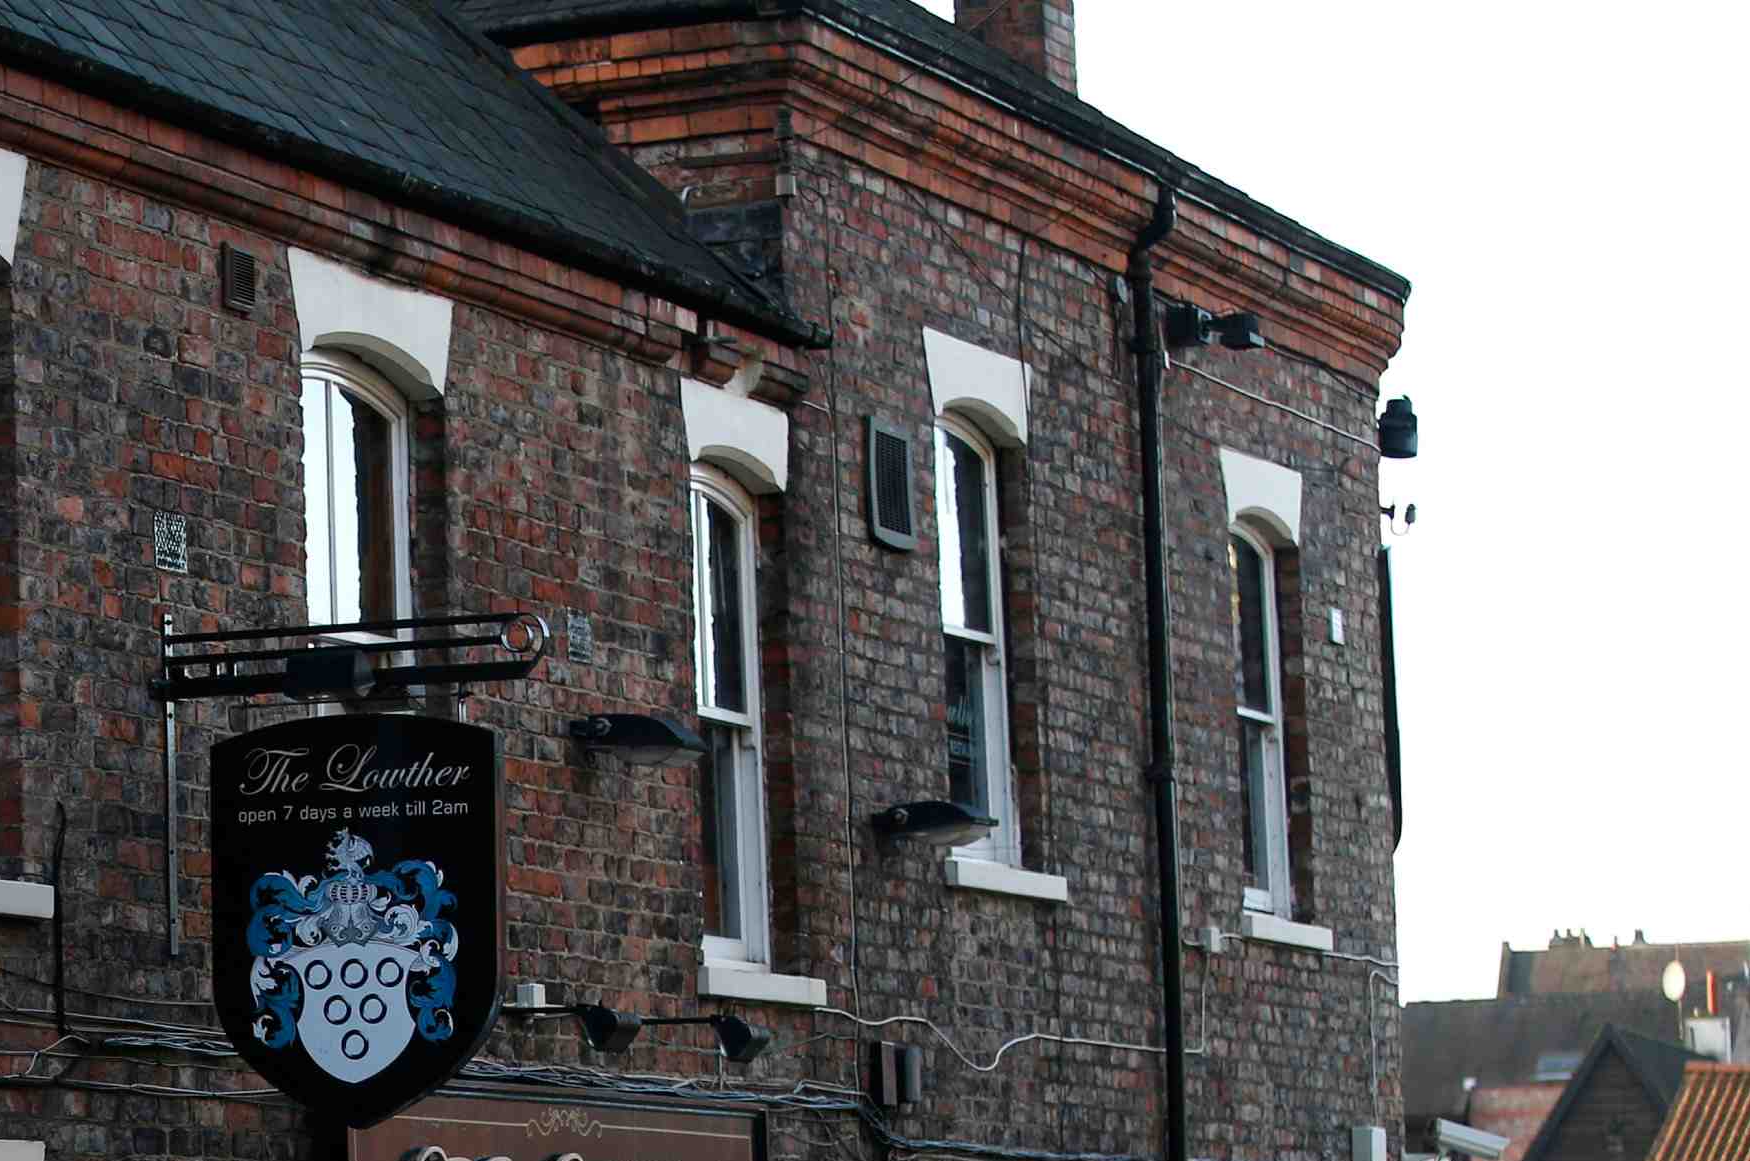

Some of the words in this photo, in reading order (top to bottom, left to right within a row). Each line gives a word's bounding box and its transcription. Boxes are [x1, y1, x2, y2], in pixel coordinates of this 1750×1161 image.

[239, 746, 310, 795] The
[318, 743, 470, 793] Lowther
[238, 807, 276, 825] open
[283, 805, 293, 821] 7
[299, 804, 337, 822] days
[342, 806, 353, 819] a
[358, 802, 400, 818] week
[405, 800, 427, 816] till
[432, 798, 469, 815] 2am
